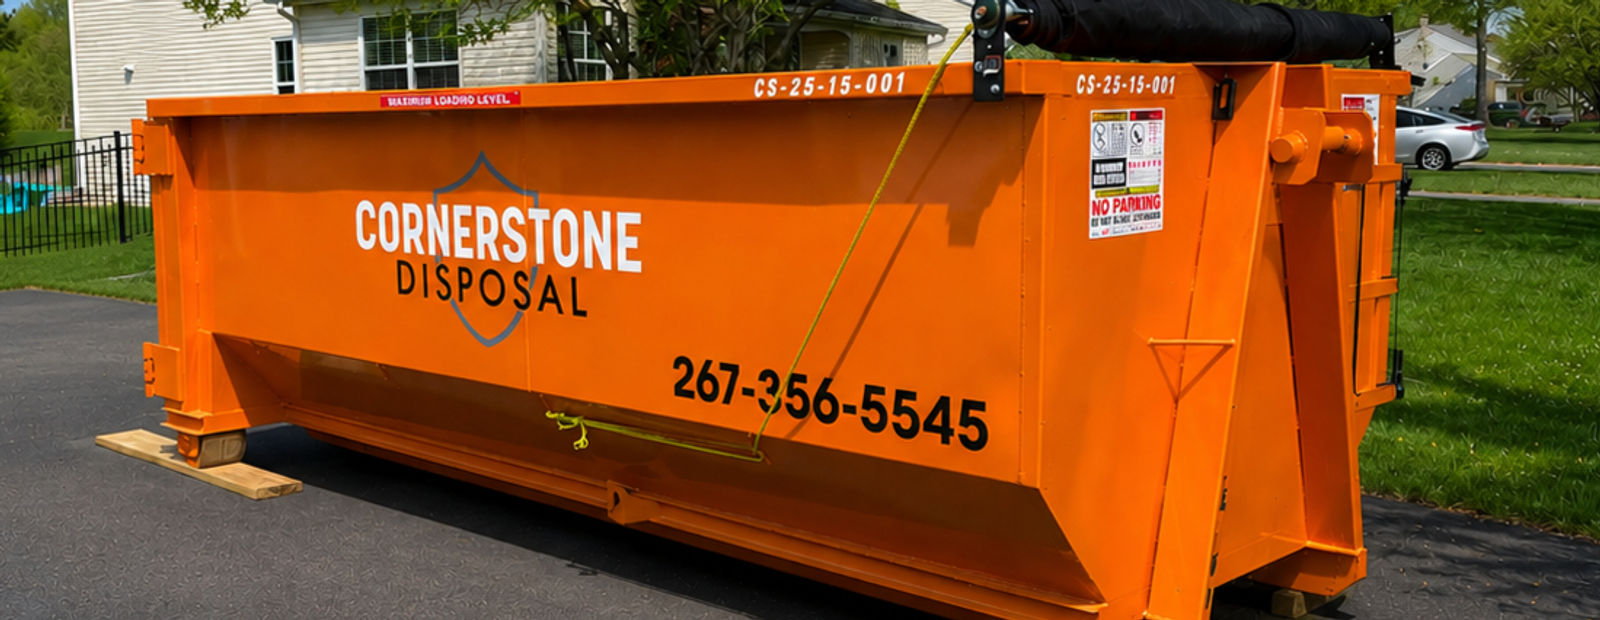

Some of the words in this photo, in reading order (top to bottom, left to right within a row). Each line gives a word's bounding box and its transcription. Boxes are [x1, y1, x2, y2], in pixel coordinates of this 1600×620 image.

[754, 72, 905, 98] CS-25-15-001
[1076, 74, 1176, 95] CS-25-15-001
[1092, 198, 1110, 216] NO
[355, 200, 642, 273] CORNERSTONE
[396, 259, 588, 318] DISPOSAL
[672, 355, 989, 452] 267-356-5545
